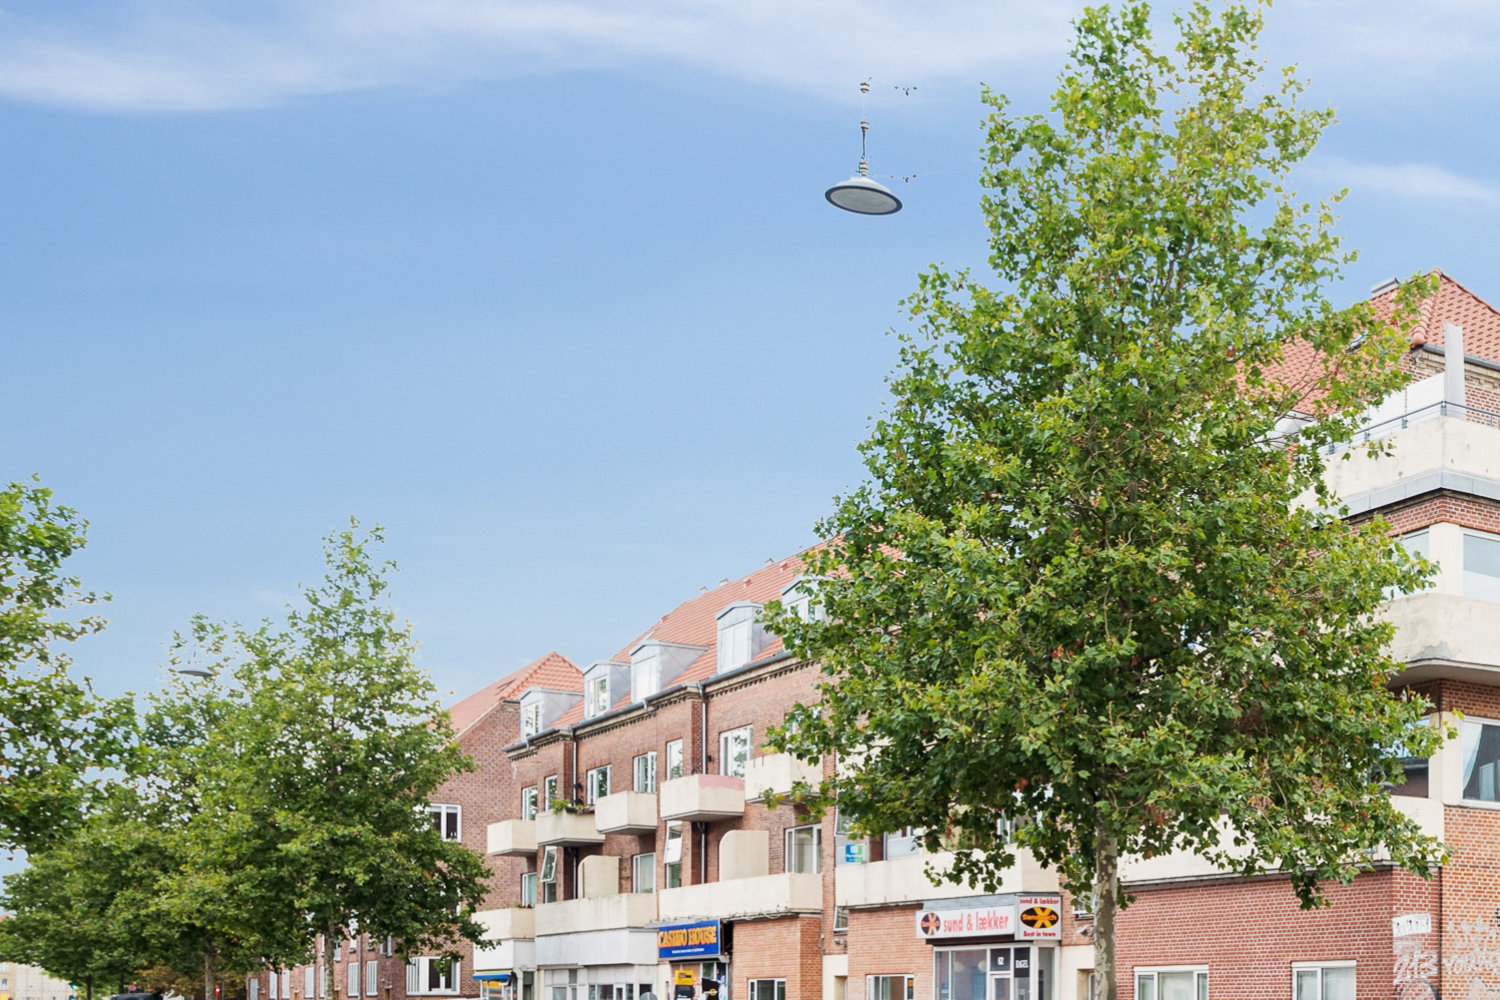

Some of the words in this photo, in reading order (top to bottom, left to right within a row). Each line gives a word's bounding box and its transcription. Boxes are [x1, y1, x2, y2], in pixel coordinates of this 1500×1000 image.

[943, 912, 964, 933] sund
[966, 913, 973, 932] &
[975, 910, 1009, 931] lækker
[659, 928, 688, 948] CASINO
[688, 925, 717, 946] HOUSE
